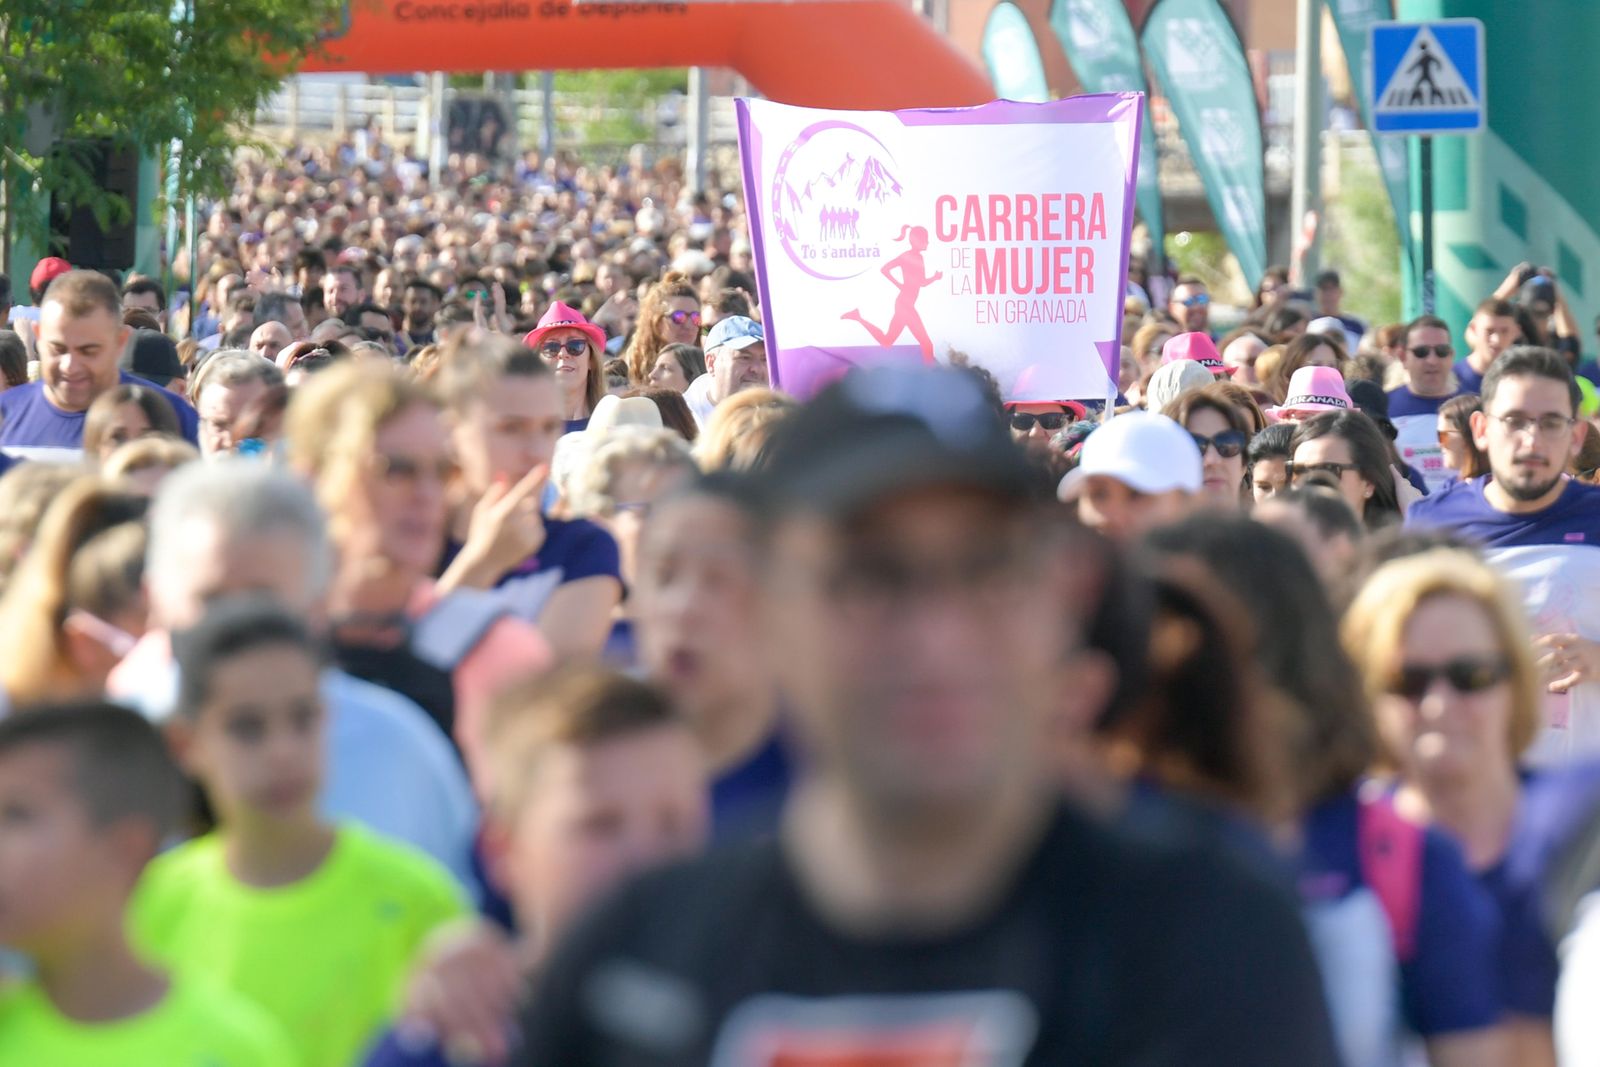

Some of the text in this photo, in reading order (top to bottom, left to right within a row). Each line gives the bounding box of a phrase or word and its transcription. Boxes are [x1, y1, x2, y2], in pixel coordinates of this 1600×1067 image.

[540, 0, 569, 18] de
[935, 192, 1107, 242] CARRERA
[951, 247, 971, 269] DE
[951, 246, 1095, 295] LA MUJER
[976, 299, 1088, 324] EN GRANADA
